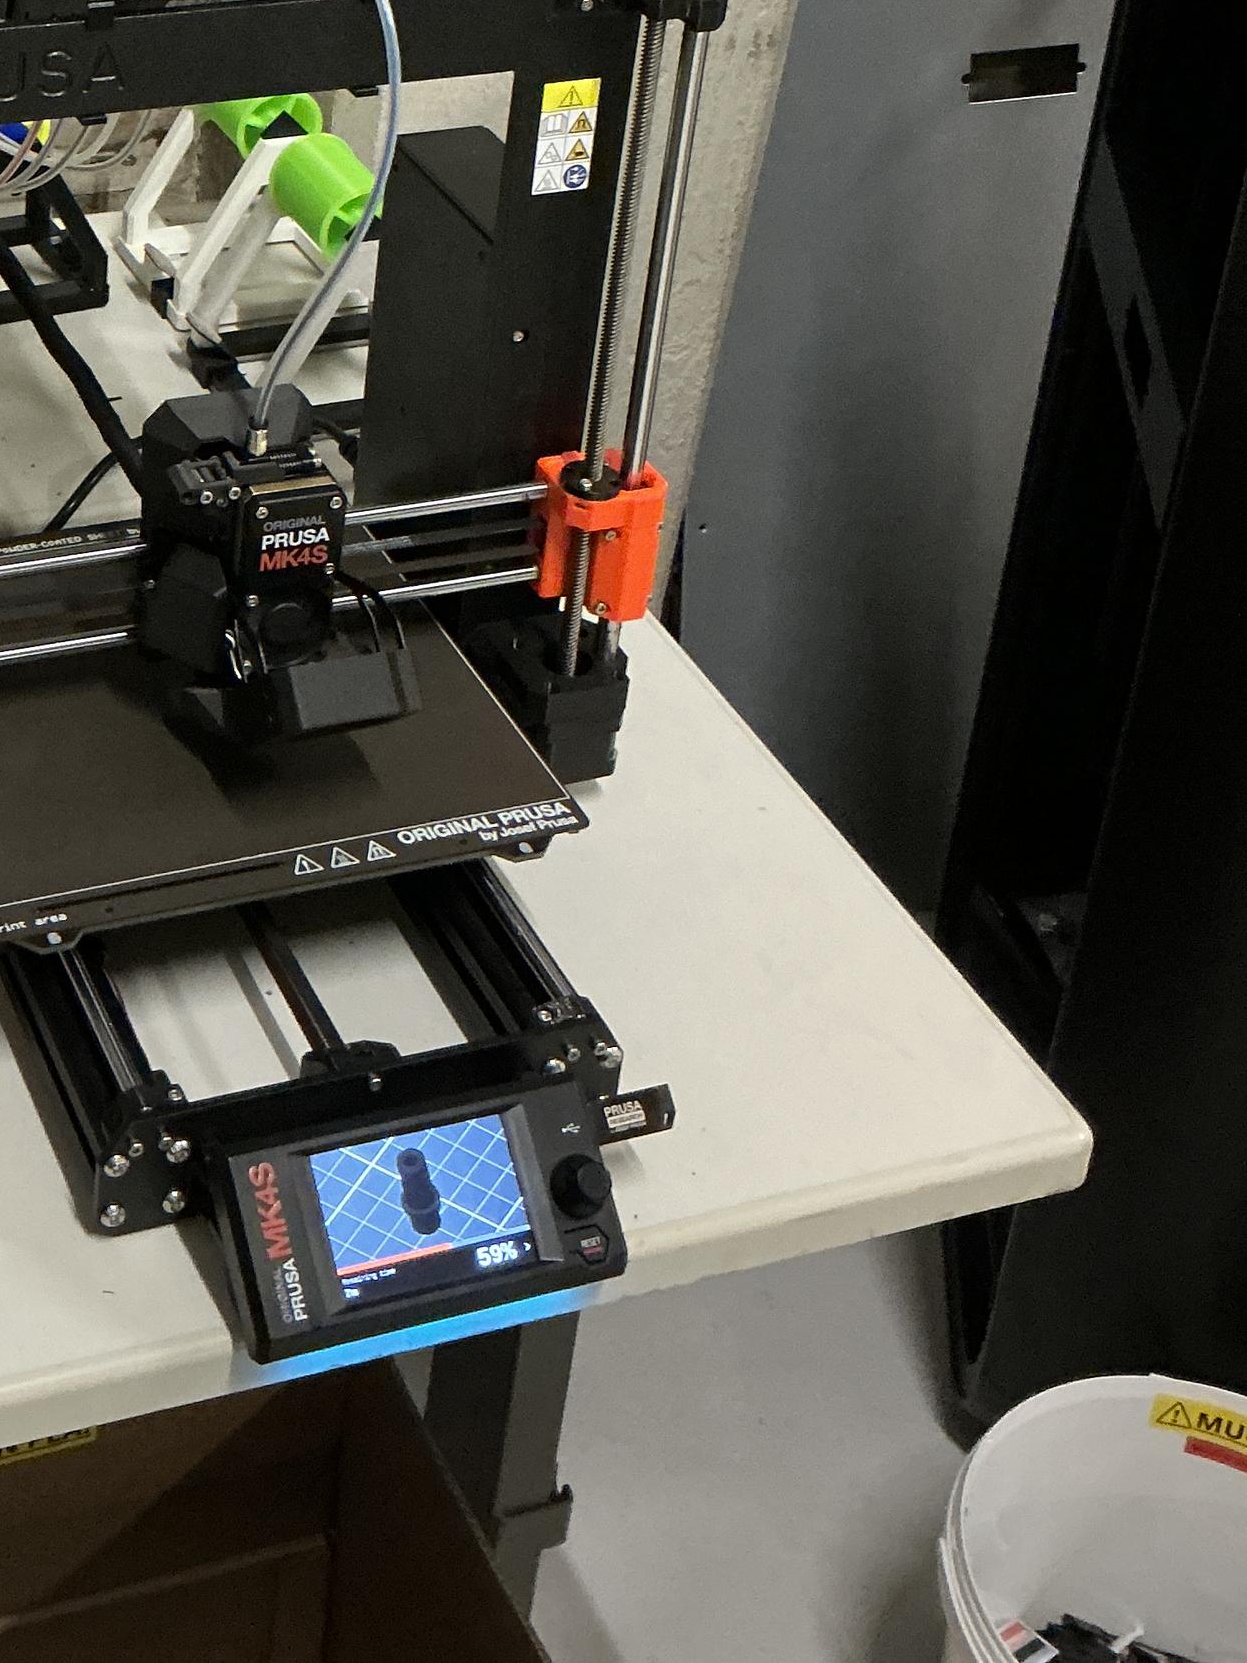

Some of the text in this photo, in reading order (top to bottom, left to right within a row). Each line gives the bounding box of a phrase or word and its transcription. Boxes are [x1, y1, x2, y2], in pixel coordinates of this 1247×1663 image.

[263, 514, 326, 532] ORIGINAL
[261, 527, 330, 551] PRUSA
[259, 544, 328, 572] MK4S
[396, 801, 571, 845] ORIGINAL PRUSA
[603, 1100, 642, 1118] PRUSA
[249, 1162, 293, 1261] MK4S
[476, 1241, 520, 1269] 59%
[282, 1257, 309, 1322] PRUSA
